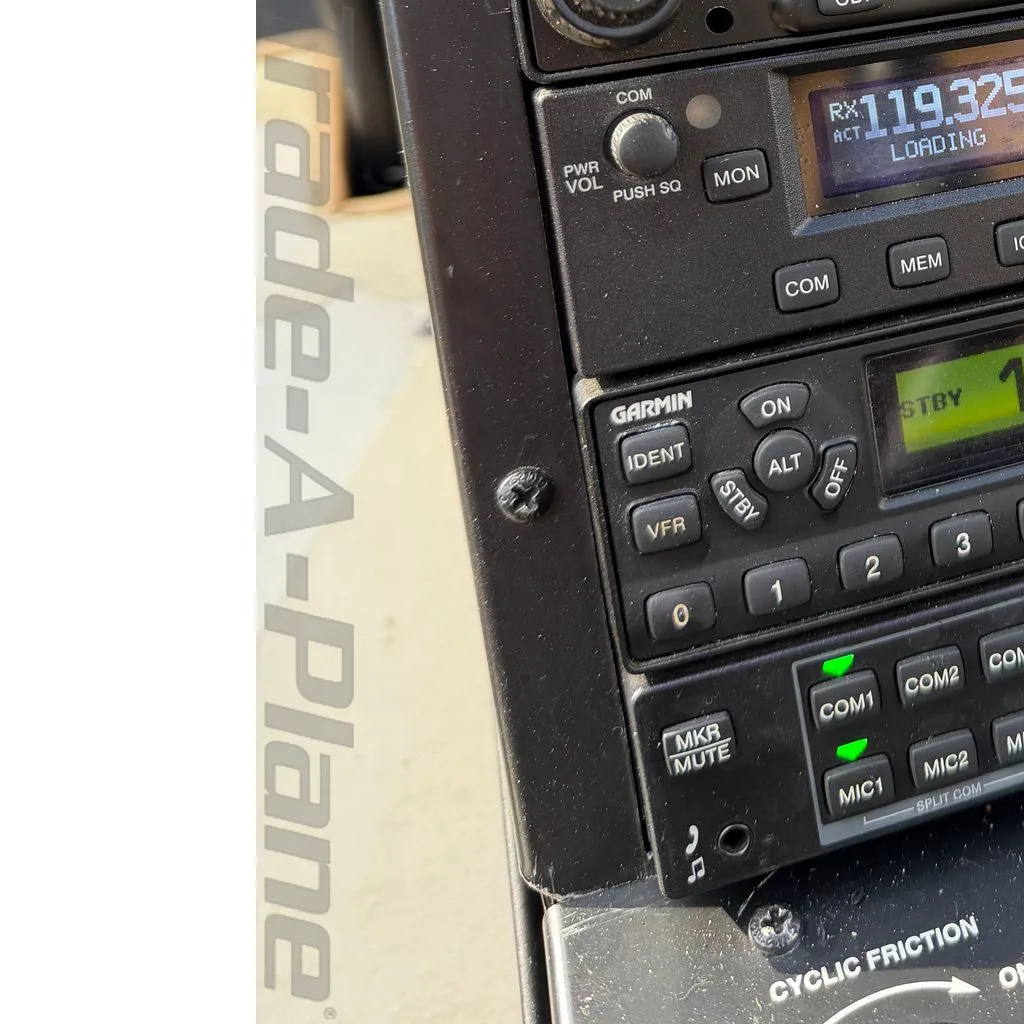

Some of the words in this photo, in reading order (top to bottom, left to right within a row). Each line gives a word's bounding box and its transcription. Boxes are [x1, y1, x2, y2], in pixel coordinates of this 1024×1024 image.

[616, 88, 653, 105] COM
[890, 127, 987, 162] LOADING
[563, 161, 600, 178] PWR
[713, 163, 760, 188] MON
[564, 176, 604, 195] VOL
[613, 186, 656, 202] PUSH
[659, 179, 682, 194] SQ
[900, 252, 943, 274] MEM
[785, 274, 830, 297] COM
[610, 390, 693, 425] GARMIN
[760, 395, 792, 418] ON
[900, 387, 963, 418] STBY
[626, 442, 685, 472] IDENT
[768, 453, 802, 478] ALT
[825, 457, 848, 498] OFF
[719, 480, 760, 523] STBY
[647, 516, 687, 542] VFR
[904, 665, 960, 694] COM2
[819, 690, 875, 719] COM1
[675, 722, 721, 751] MKR
[923, 750, 969, 780] MIC2
[838, 778, 884, 807] MIC1
[916, 789, 950, 813] SPLIT
[952, 780, 983, 805] COM
[769, 956, 862, 1003] CYCLIC
[865, 915, 981, 973] FRICTION
